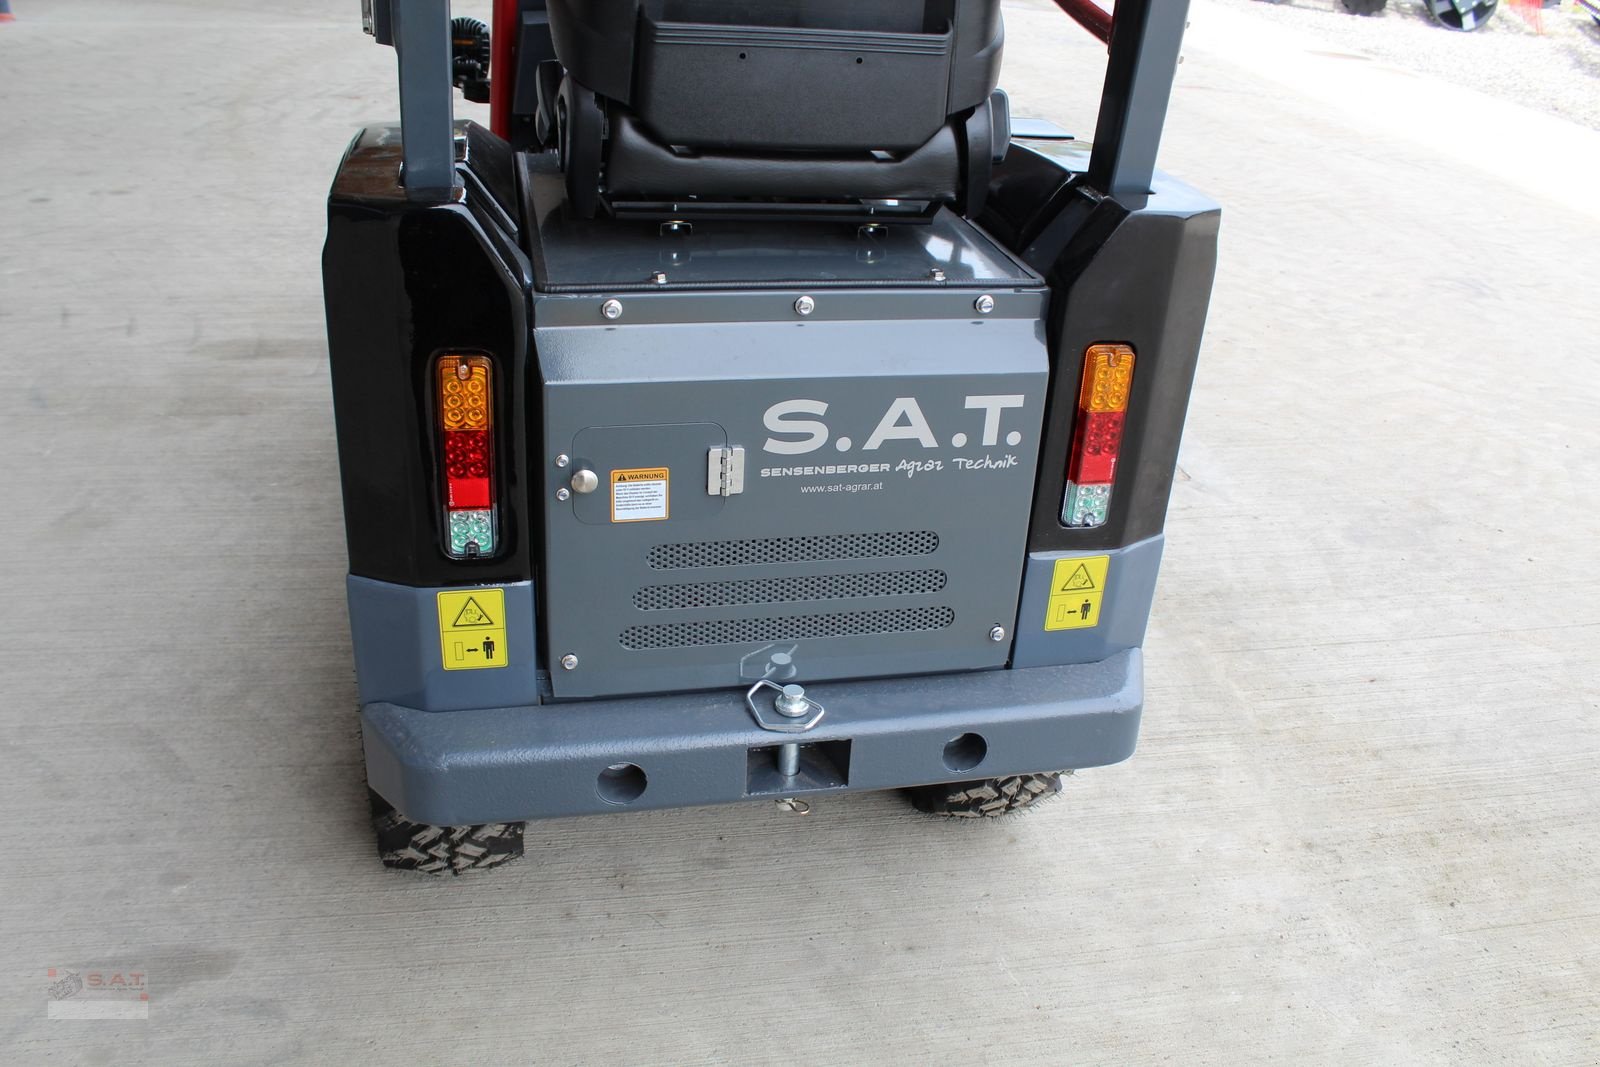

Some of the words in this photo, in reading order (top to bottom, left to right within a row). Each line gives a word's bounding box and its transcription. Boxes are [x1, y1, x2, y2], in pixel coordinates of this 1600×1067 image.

[763, 394, 1025, 455] S.A.T.
[628, 472, 664, 480] WARNUNG
[760, 463, 890, 477] SENSENBERGER
[895, 458, 944, 479] Agrar
[952, 454, 1019, 471] Technik
[800, 481, 883, 494] www.sat-agrar.at
